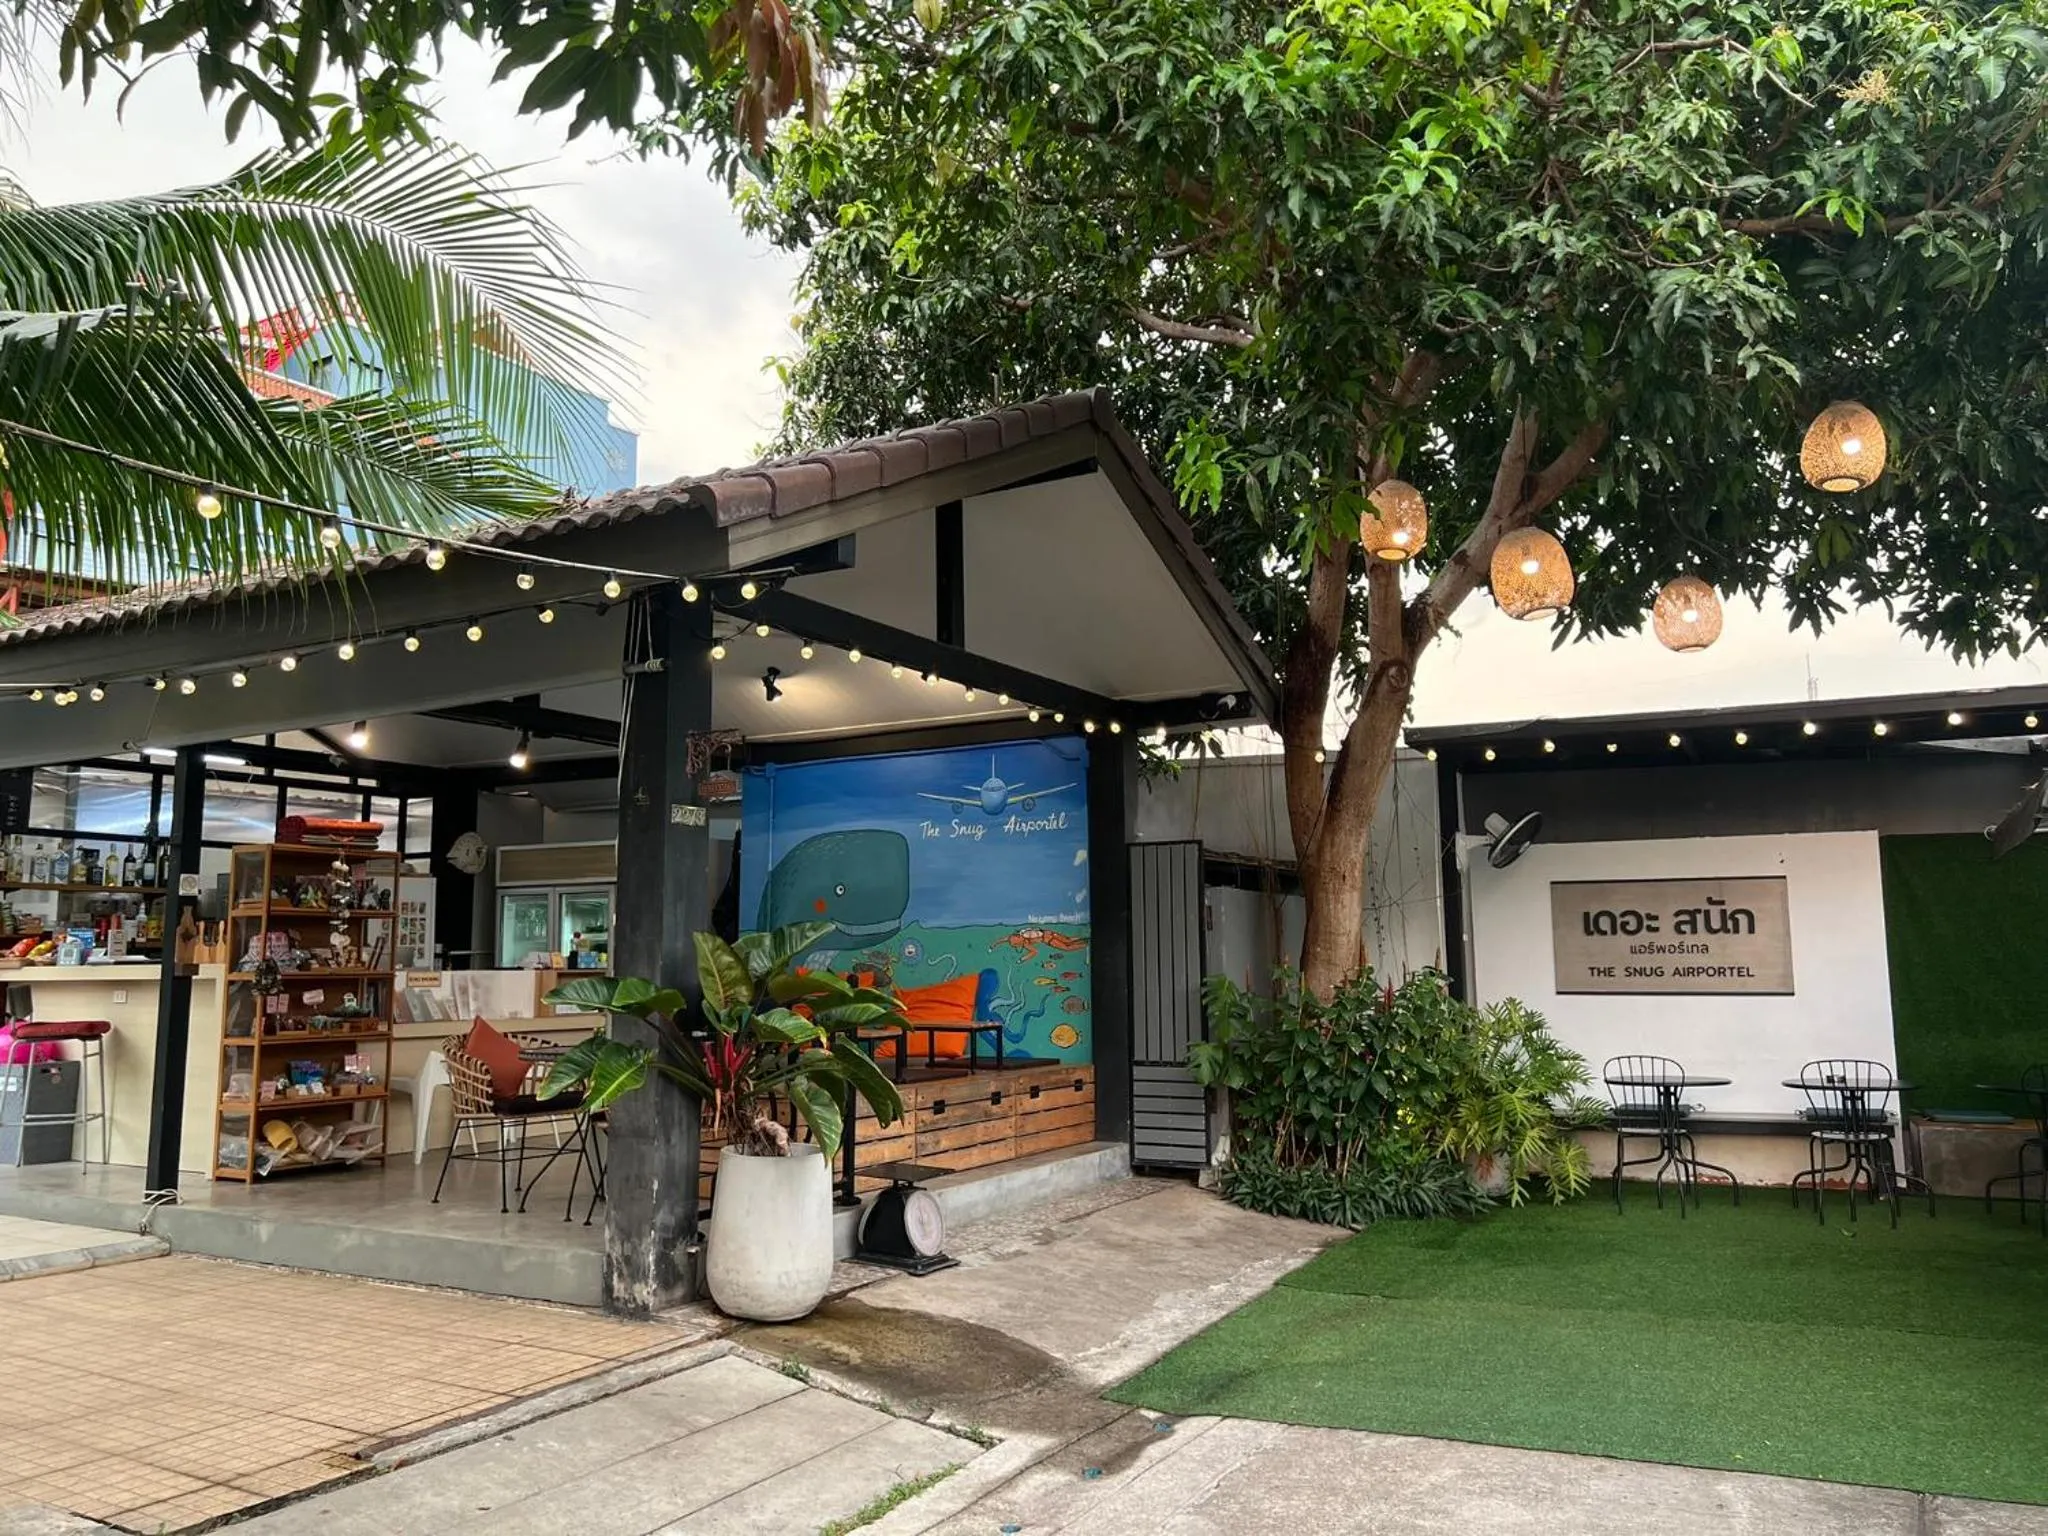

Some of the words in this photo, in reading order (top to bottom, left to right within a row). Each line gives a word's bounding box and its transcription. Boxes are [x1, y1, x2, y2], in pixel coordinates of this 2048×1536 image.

[919, 820, 940, 839] The
[950, 818, 987, 841] Snug
[1003, 811, 1069, 837] Airportel
[1582, 909, 1660, 936] เดอะ
[1673, 896, 1756, 936] สนัก
[1588, 966, 1616, 977] THE
[1624, 966, 1665, 978] SNUG
[1672, 965, 1755, 978] AIRPORTEL
